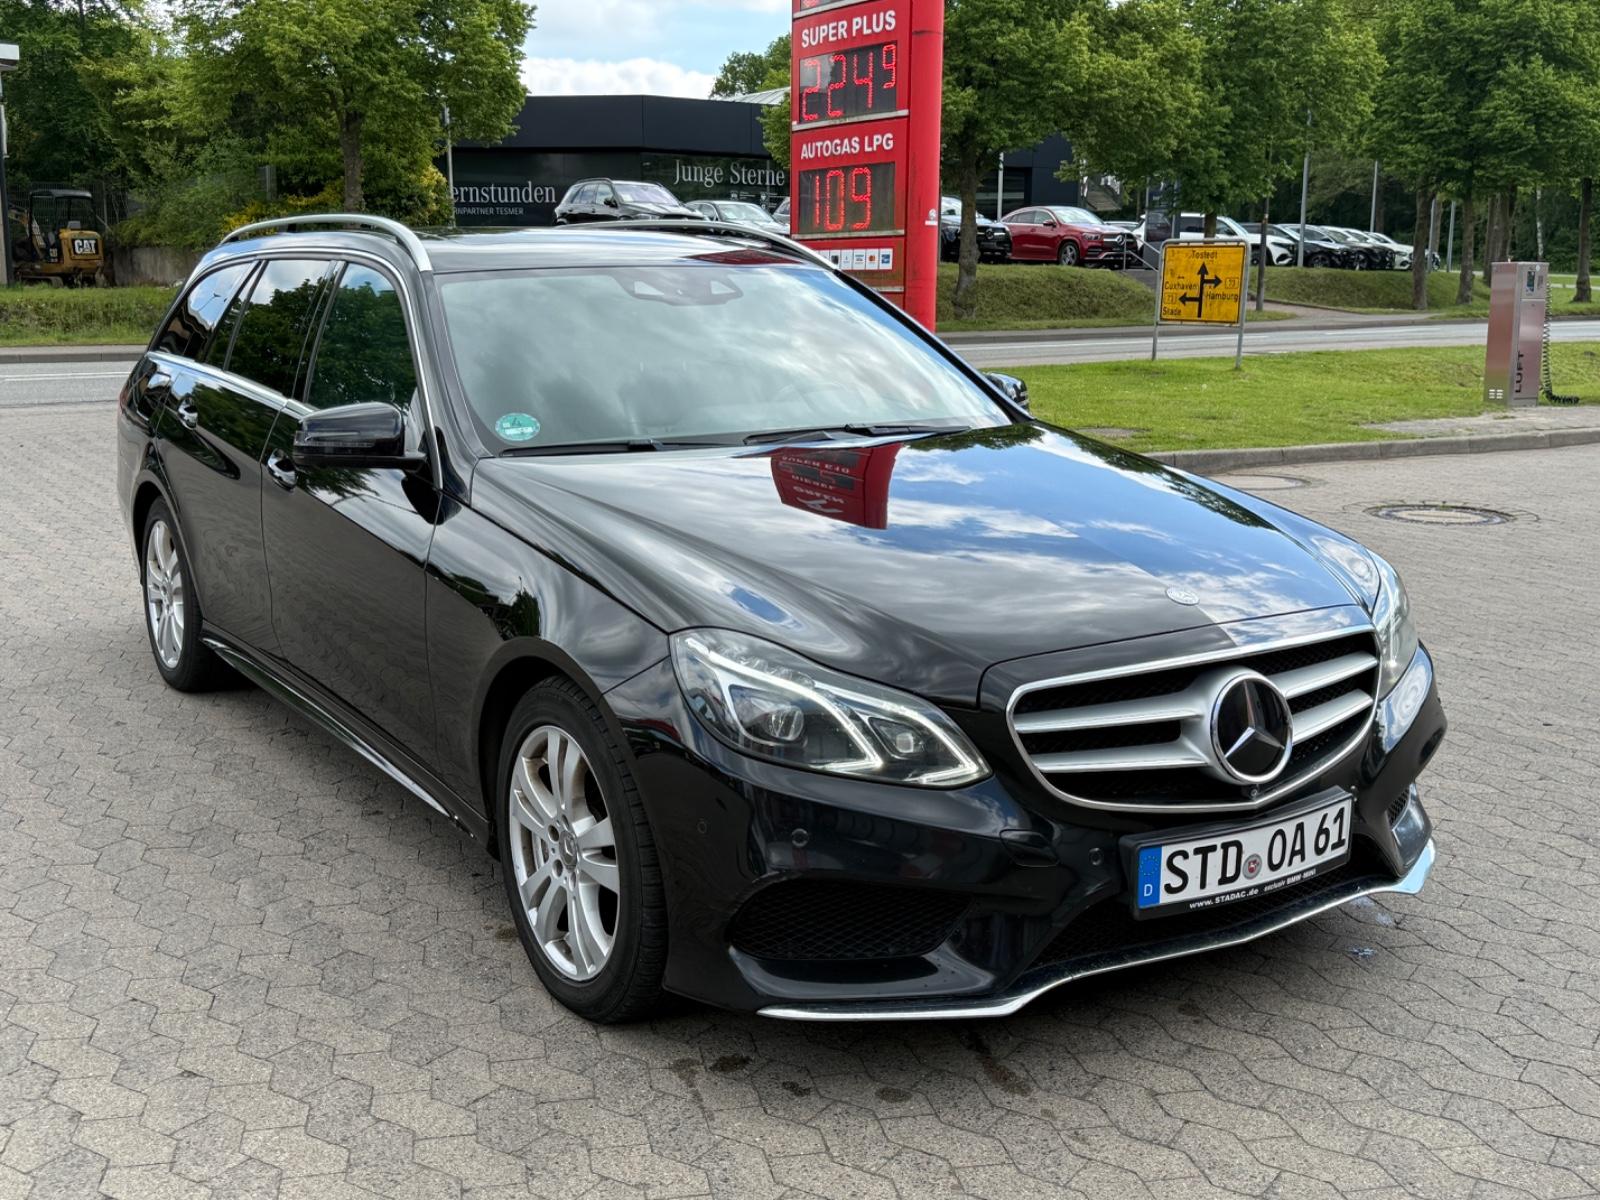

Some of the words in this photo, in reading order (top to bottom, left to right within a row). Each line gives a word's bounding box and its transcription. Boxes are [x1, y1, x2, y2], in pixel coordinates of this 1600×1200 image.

[801, 20, 848, 48] SUPER
[852, 10, 896, 36] PLUS
[801, 136, 860, 160] AUTOGAS
[864, 133, 894, 152] LPG
[674, 160, 724, 188] Junge
[730, 161, 785, 186] Sterne
[815, 167, 872, 231] 109
[496, 207, 524, 216] TESMER
[74, 240, 96, 254] CAT
[1192, 250, 1218, 259] Tostedt
[1165, 281, 1197, 290] Cuxhaven
[1205, 292, 1238, 303] Hamburg
[1162, 307, 1181, 316] Stade
[1515, 351, 1524, 393] LUFT
[1164, 839, 1243, 894] STD
[1267, 821, 1306, 872] OA
[1314, 807, 1346, 856] 61
[1144, 884, 1153, 896] D
